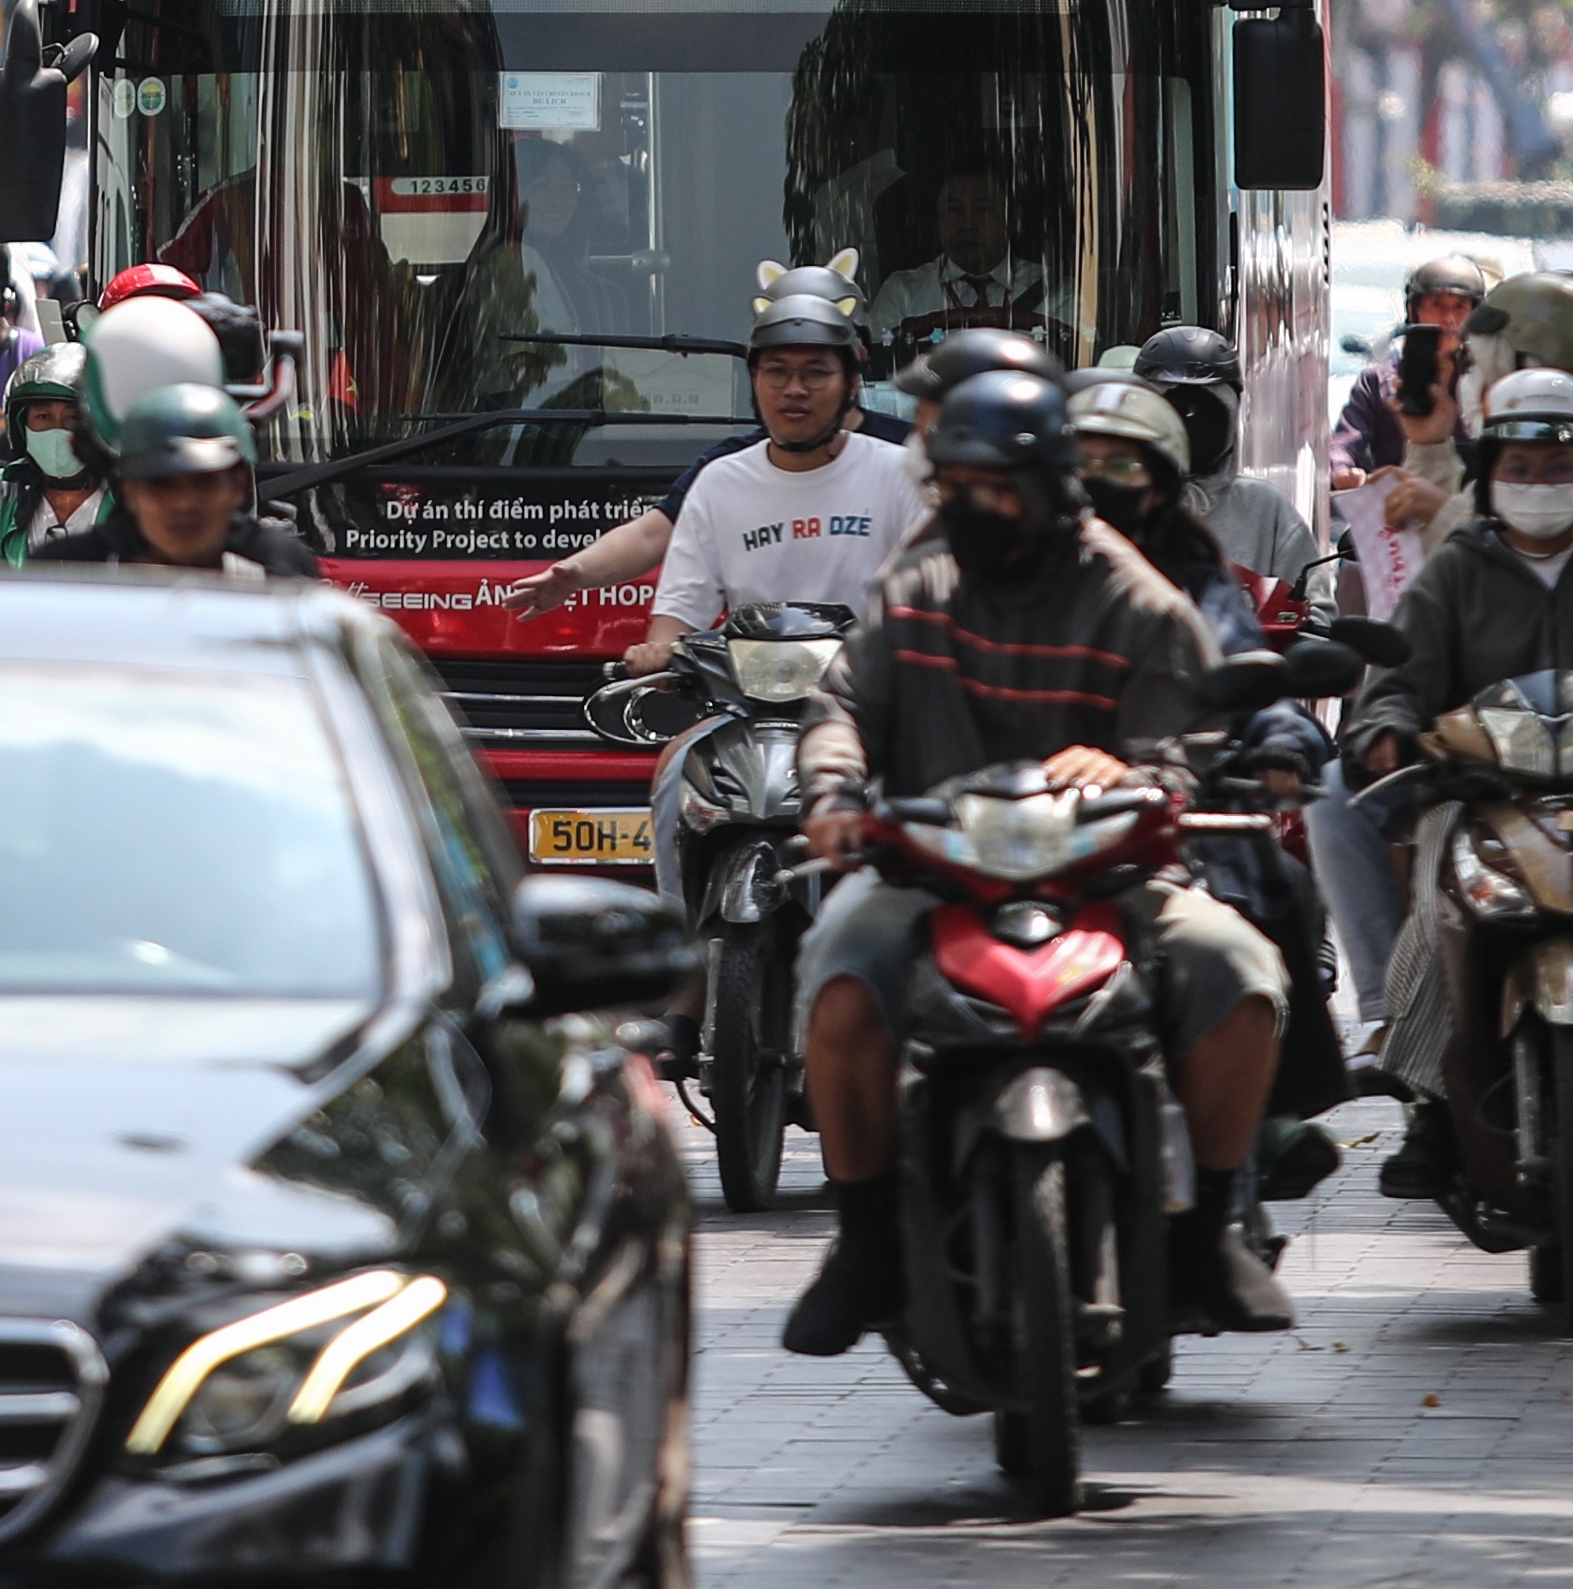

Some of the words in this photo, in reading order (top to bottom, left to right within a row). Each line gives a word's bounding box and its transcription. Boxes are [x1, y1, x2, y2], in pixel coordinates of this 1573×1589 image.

[411, 178, 486, 194] 123456
[386, 500, 419, 524] Dự
[423, 500, 451, 520] án
[454, 500, 483, 520] thí
[489, 497, 544, 521] điểm
[549, 500, 600, 524] phát
[346, 529, 427, 554] Priority
[432, 529, 509, 554] Project
[514, 532, 538, 549] to
[743, 523, 784, 552] HAY
[792, 517, 822, 539] RA
[475, 578, 513, 606] ẢN
